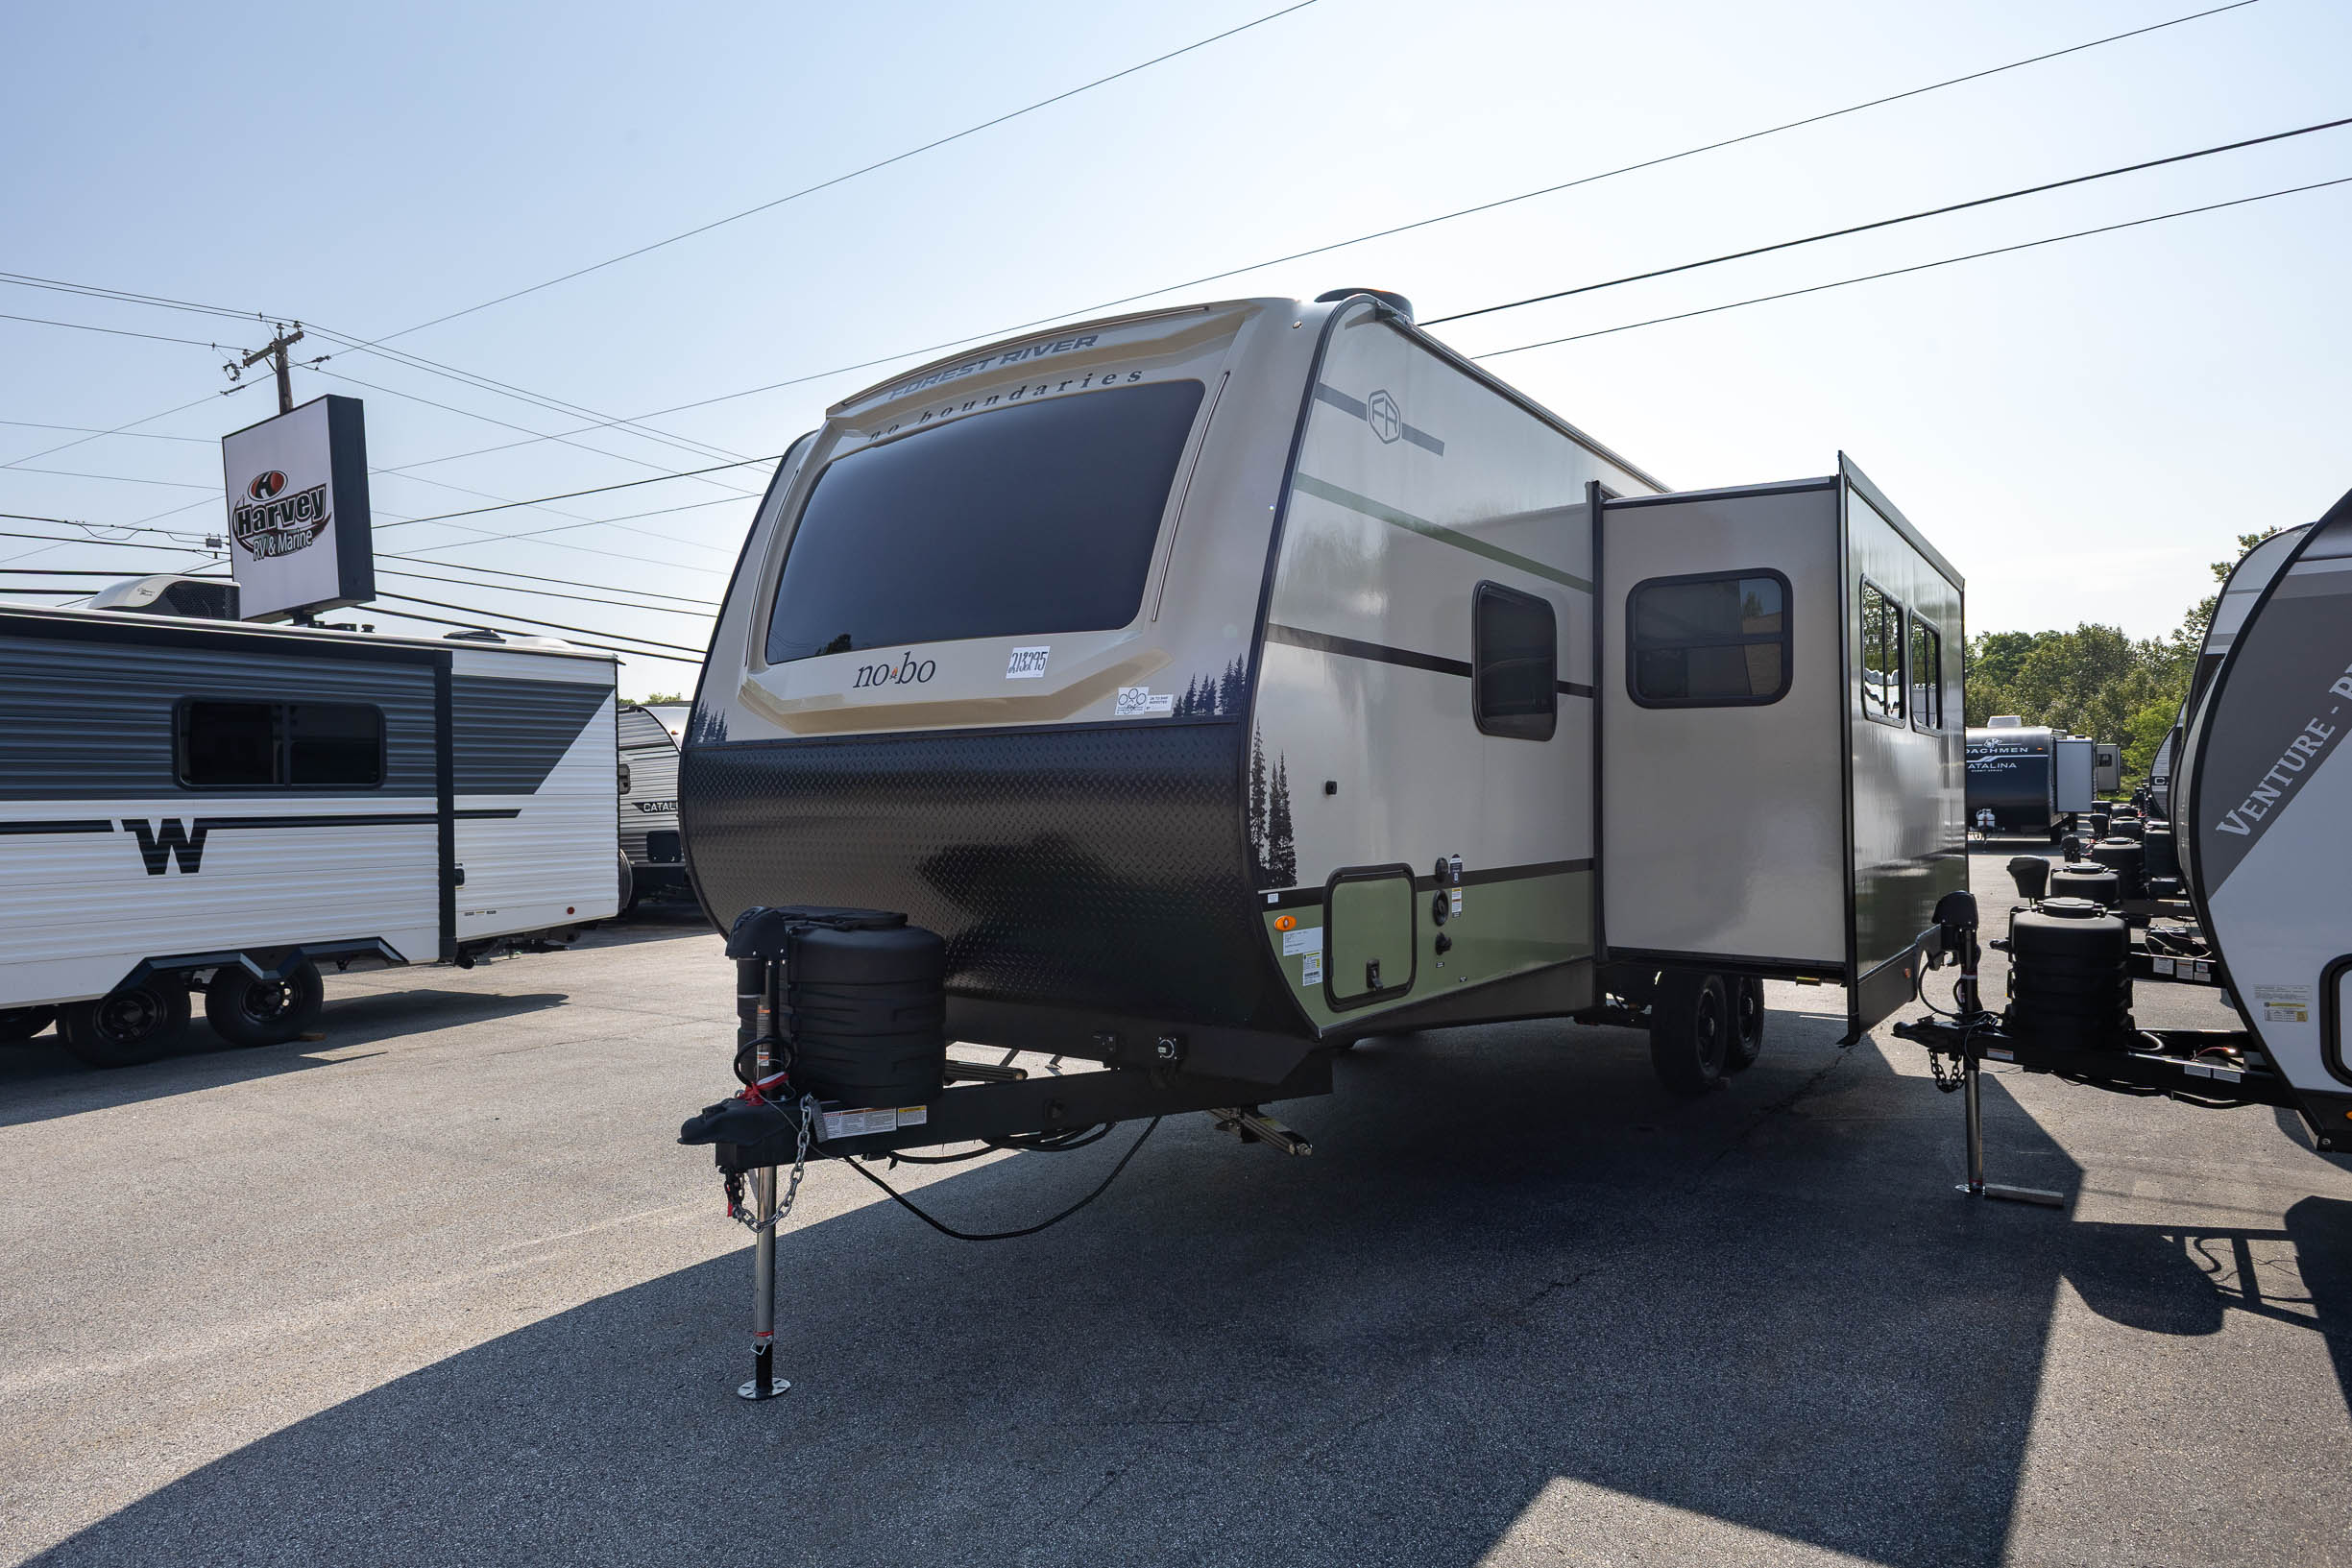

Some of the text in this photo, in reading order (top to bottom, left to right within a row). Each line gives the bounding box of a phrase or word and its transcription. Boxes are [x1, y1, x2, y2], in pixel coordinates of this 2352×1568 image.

[887, 335, 1099, 400] FOREST RIVER
[868, 370, 1143, 443] no boundaries
[235, 486, 327, 539] Harvey
[254, 529, 313, 561] RV & Marine
[2215, 717, 2336, 836] VENTURE
[121, 817, 208, 876] W
